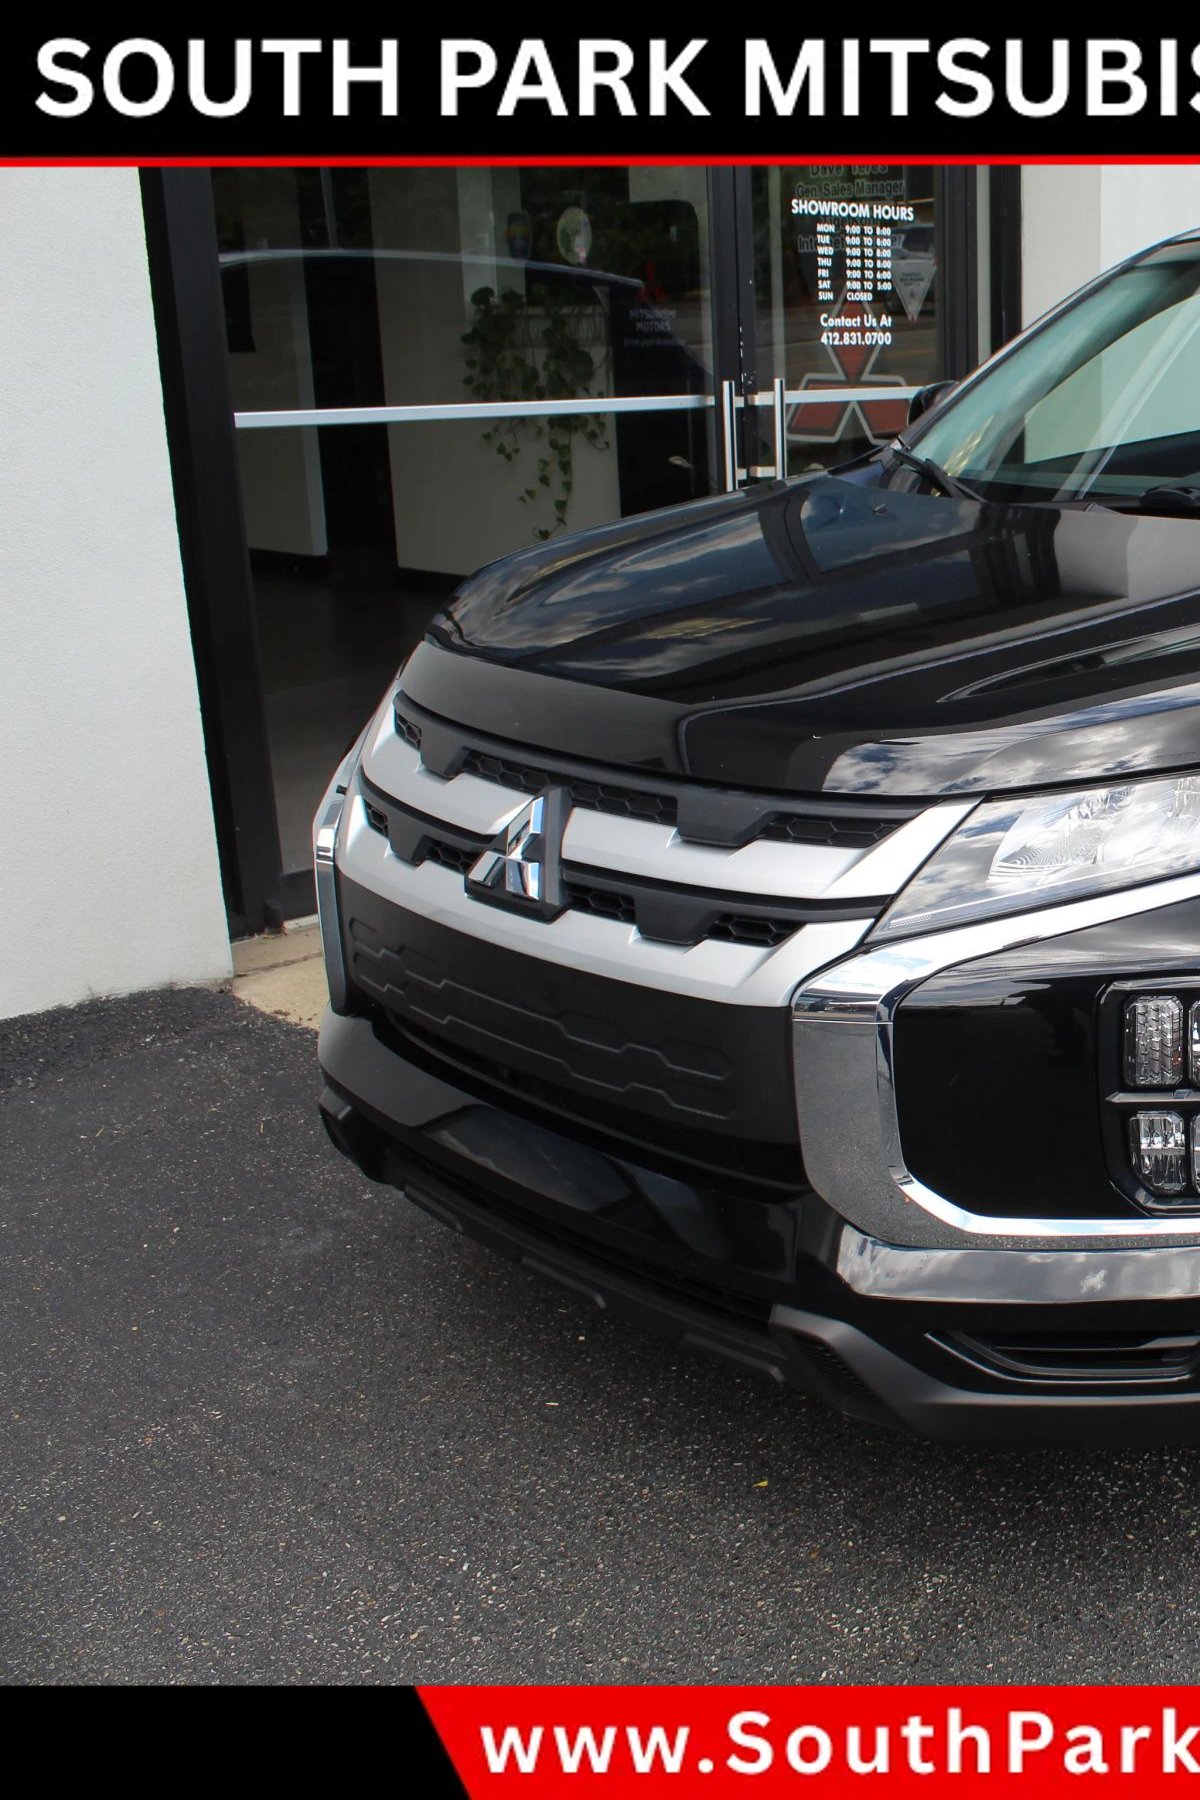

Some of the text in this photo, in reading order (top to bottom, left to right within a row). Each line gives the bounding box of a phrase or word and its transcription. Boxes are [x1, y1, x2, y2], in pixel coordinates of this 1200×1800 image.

[822, 180, 854, 198] Sales
[854, 178, 904, 198] Manager
[791, 199, 914, 221] SHOWROOM HOURS
[816, 223, 835, 233] MON
[863, 226, 873, 235] TO
[816, 235, 830, 244] TUE
[863, 237, 873, 246] TO
[817, 246, 834, 255] WED
[864, 248, 873, 257] TO
[817, 257, 832, 267] THU
[864, 259, 874, 268] TO
[817, 269, 829, 278] FRI
[864, 270, 873, 279] TO
[818, 280, 831, 289] SAT
[863, 281, 873, 290] TO
[818, 291, 873, 301] SUN CLOSED
[820, 313, 892, 327] Contact Us At
[820, 331, 892, 345] 412.831.0700
